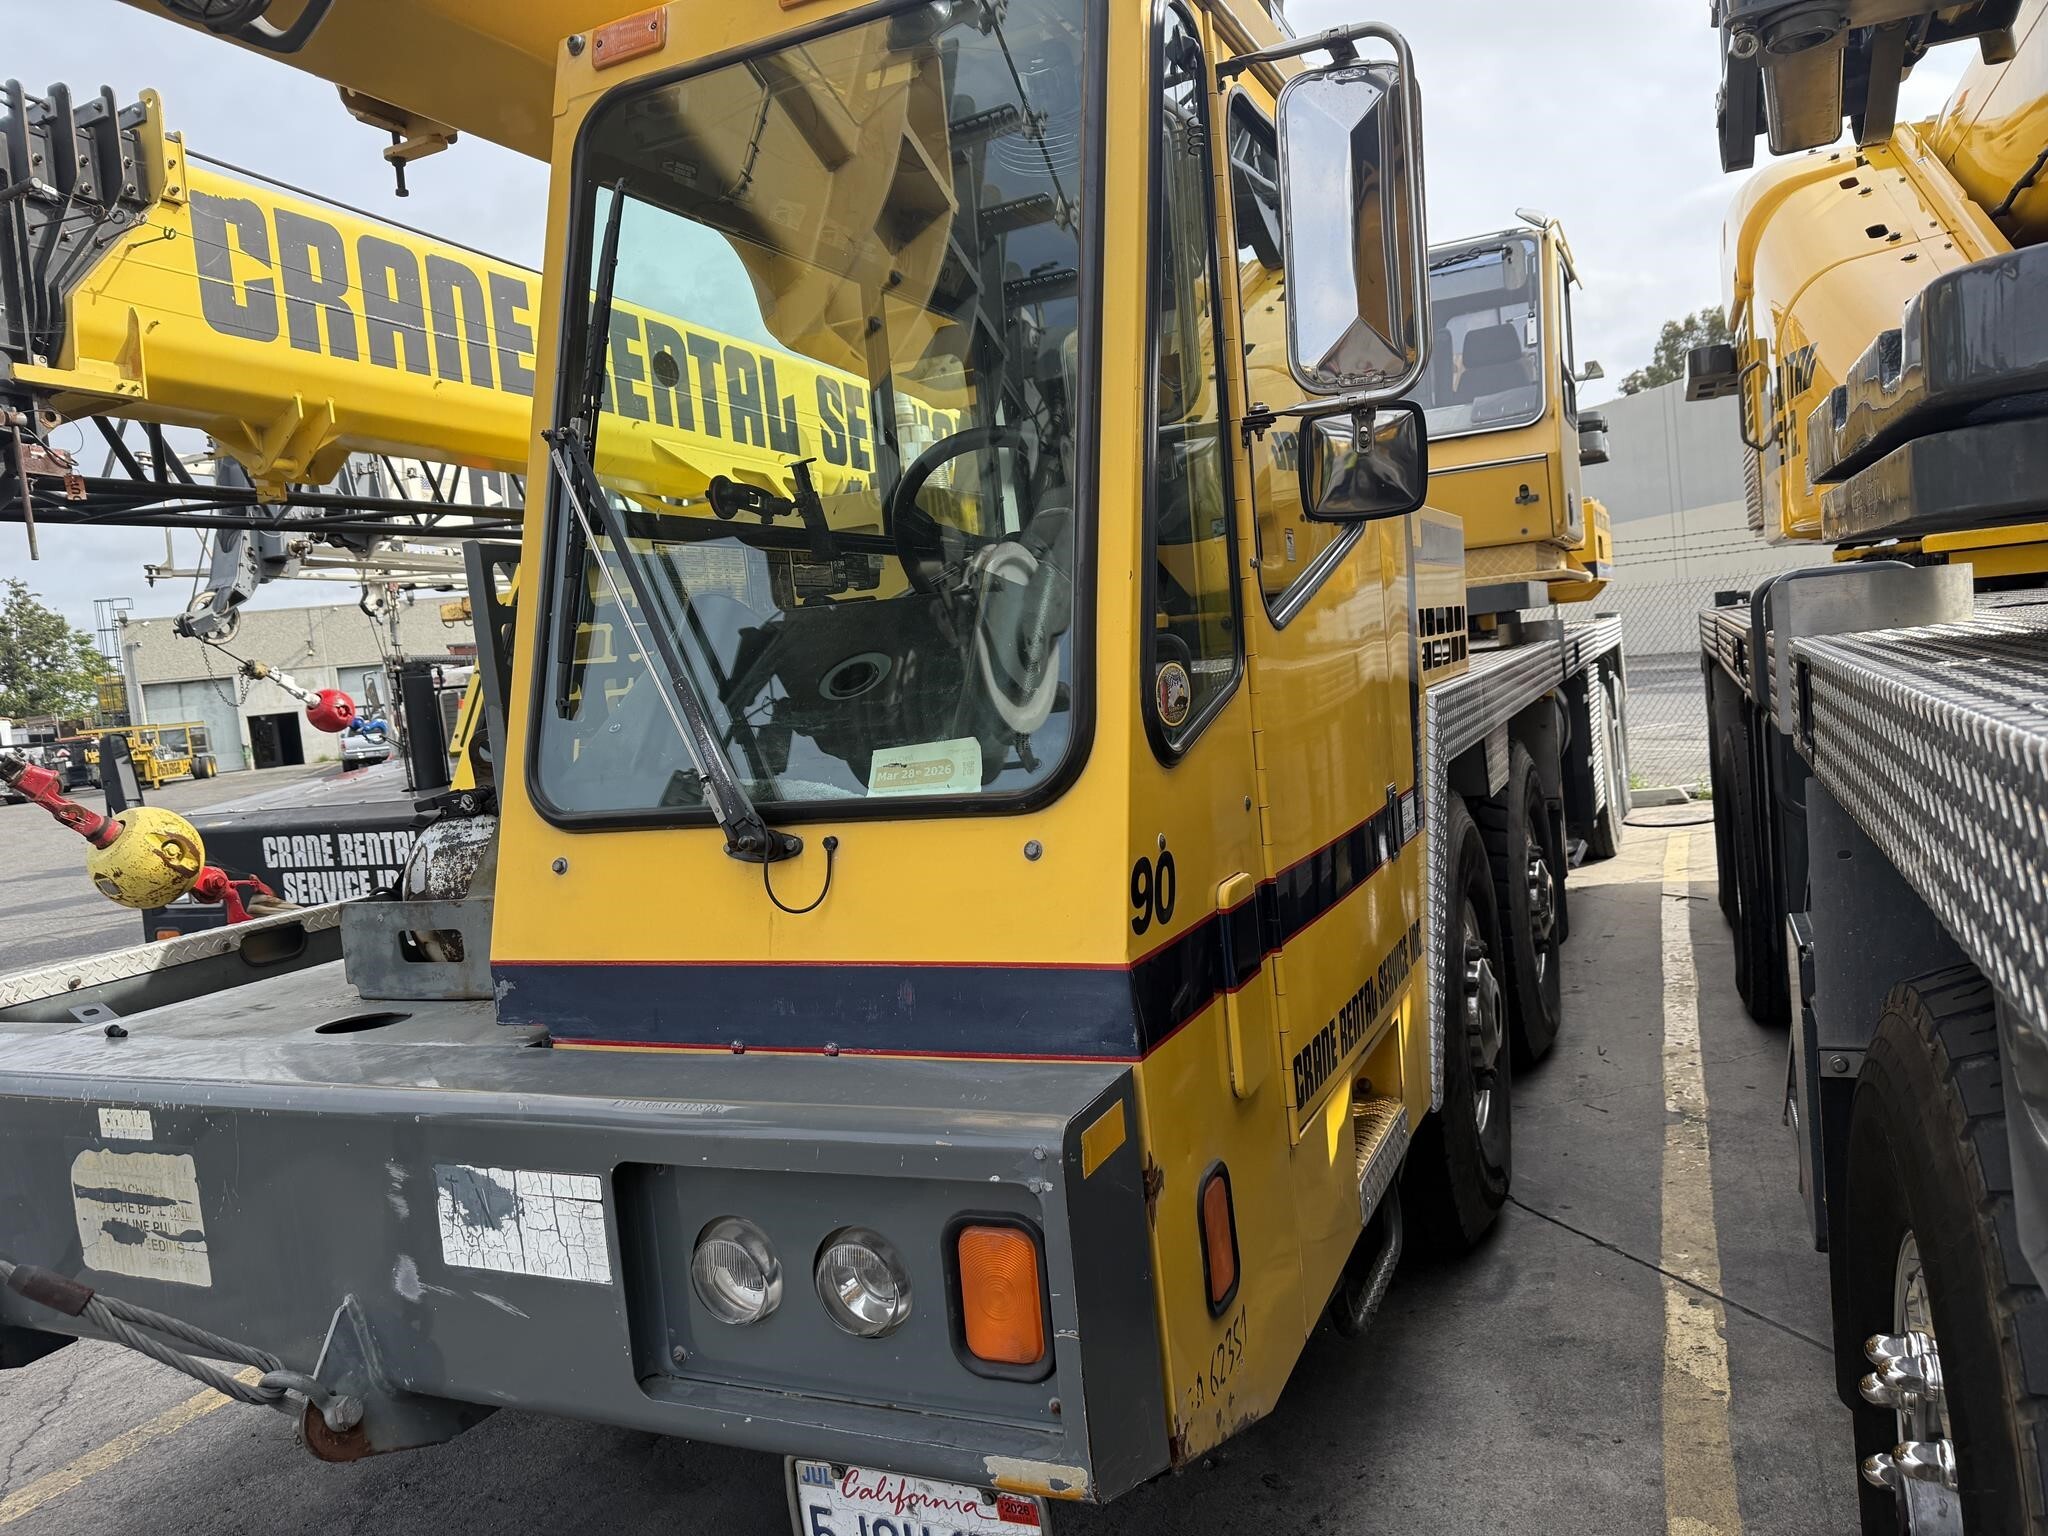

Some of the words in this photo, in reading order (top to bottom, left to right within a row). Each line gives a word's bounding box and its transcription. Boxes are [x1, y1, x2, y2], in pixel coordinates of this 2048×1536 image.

[189, 189, 535, 397] CRANE
[603, 309, 801, 456] ENTAL
[878, 771, 898, 781] Mar
[924, 765, 952, 777] 2026
[262, 834, 335, 868] CRANE
[282, 870, 371, 904] SERVICE
[1131, 851, 1175, 935] 90
[1293, 1017, 1338, 1112] CRANE
[1339, 976, 1378, 1060] RENTAL
[1377, 934, 1409, 1010] SERVICE
[802, 1466, 833, 1486] JUL
[841, 1469, 998, 1521] California
